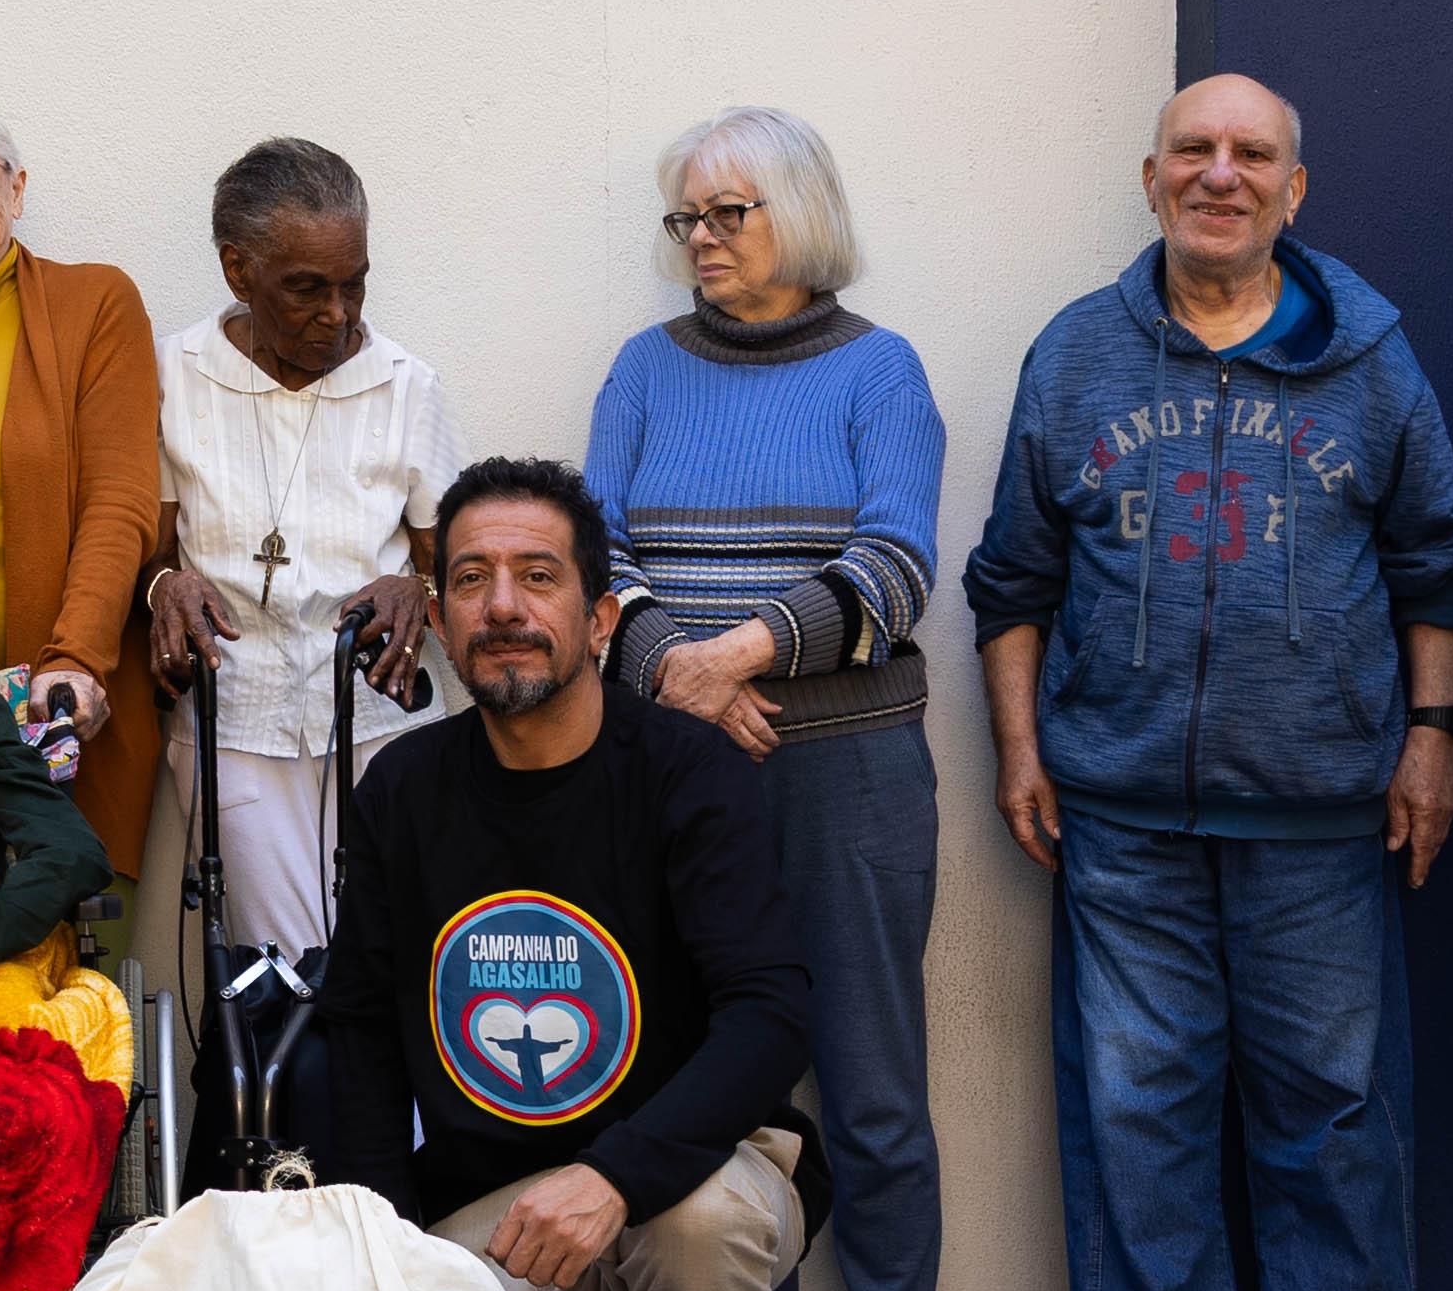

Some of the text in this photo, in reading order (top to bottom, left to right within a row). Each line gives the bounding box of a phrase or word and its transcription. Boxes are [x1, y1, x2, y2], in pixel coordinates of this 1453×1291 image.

[1079, 400, 1182, 490] GRAND
[467, 933, 579, 963] CAMPANHA DO
[467, 962, 583, 990] AGASALHO
